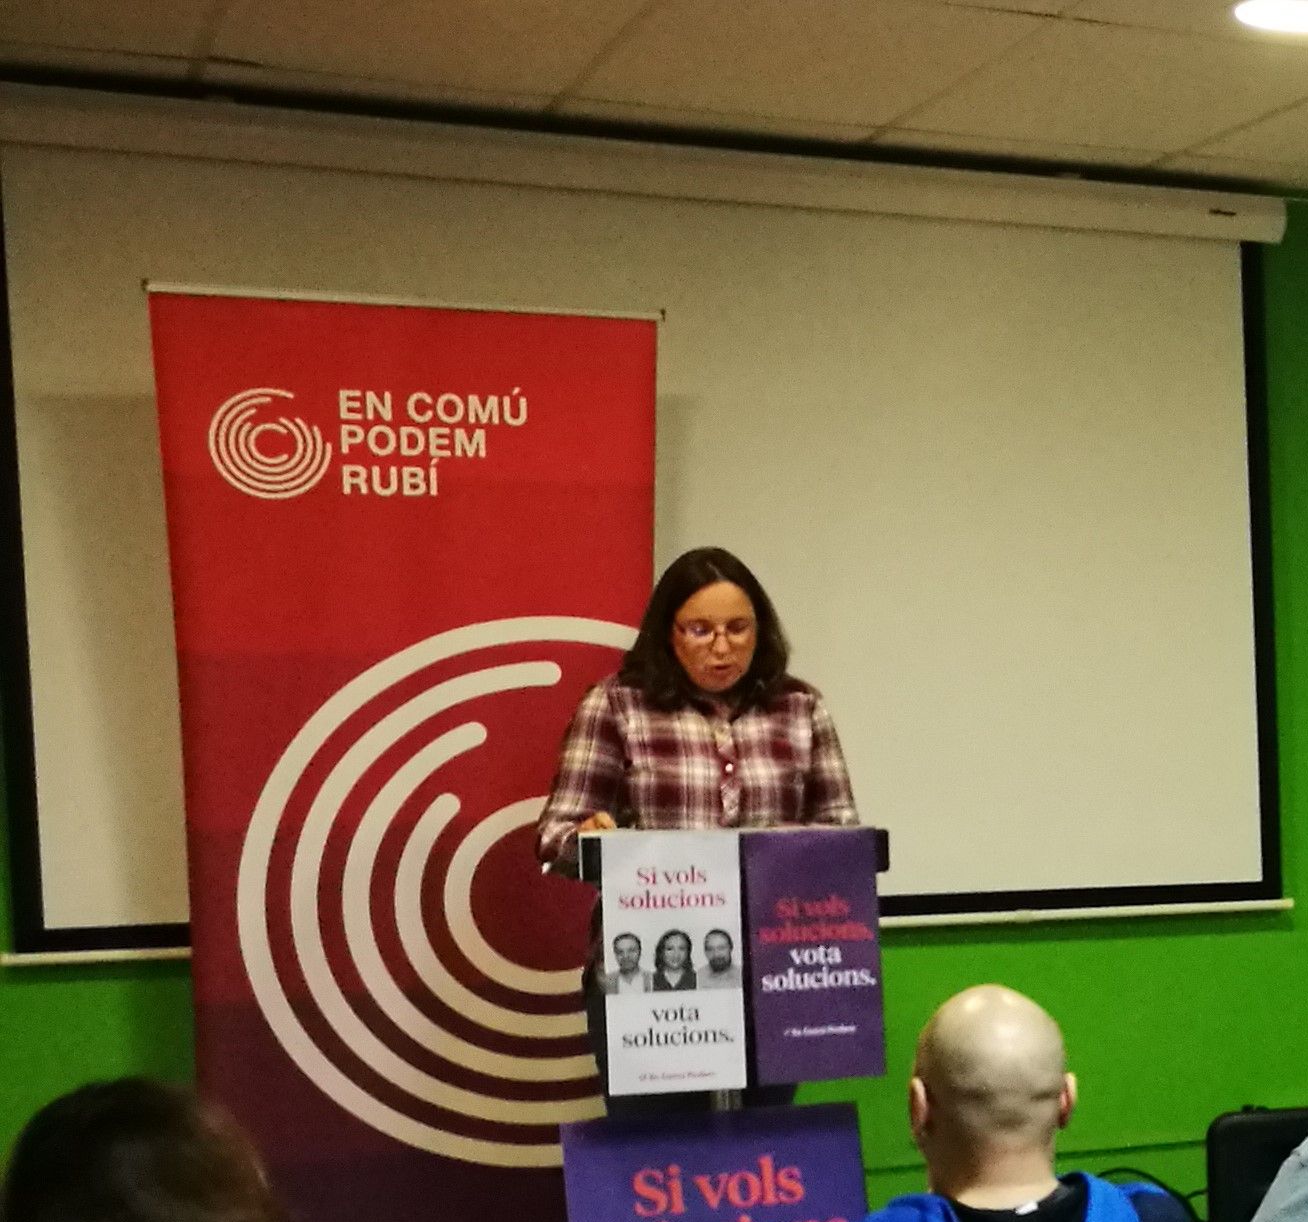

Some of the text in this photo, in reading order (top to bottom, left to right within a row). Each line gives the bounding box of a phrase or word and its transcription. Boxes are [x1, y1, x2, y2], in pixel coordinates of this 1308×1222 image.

[338, 387, 528, 427] EN COMÚ
[340, 424, 486, 458] PODEM
[342, 457, 438, 497] RUBÍ
[635, 865, 708, 887] Si vols
[618, 888, 726, 911] solucions
[789, 945, 843, 966] vota
[761, 965, 877, 992] solucions.
[651, 1003, 700, 1024] vota
[622, 1026, 735, 1049] solucions.
[632, 1154, 806, 1218] Si vols
